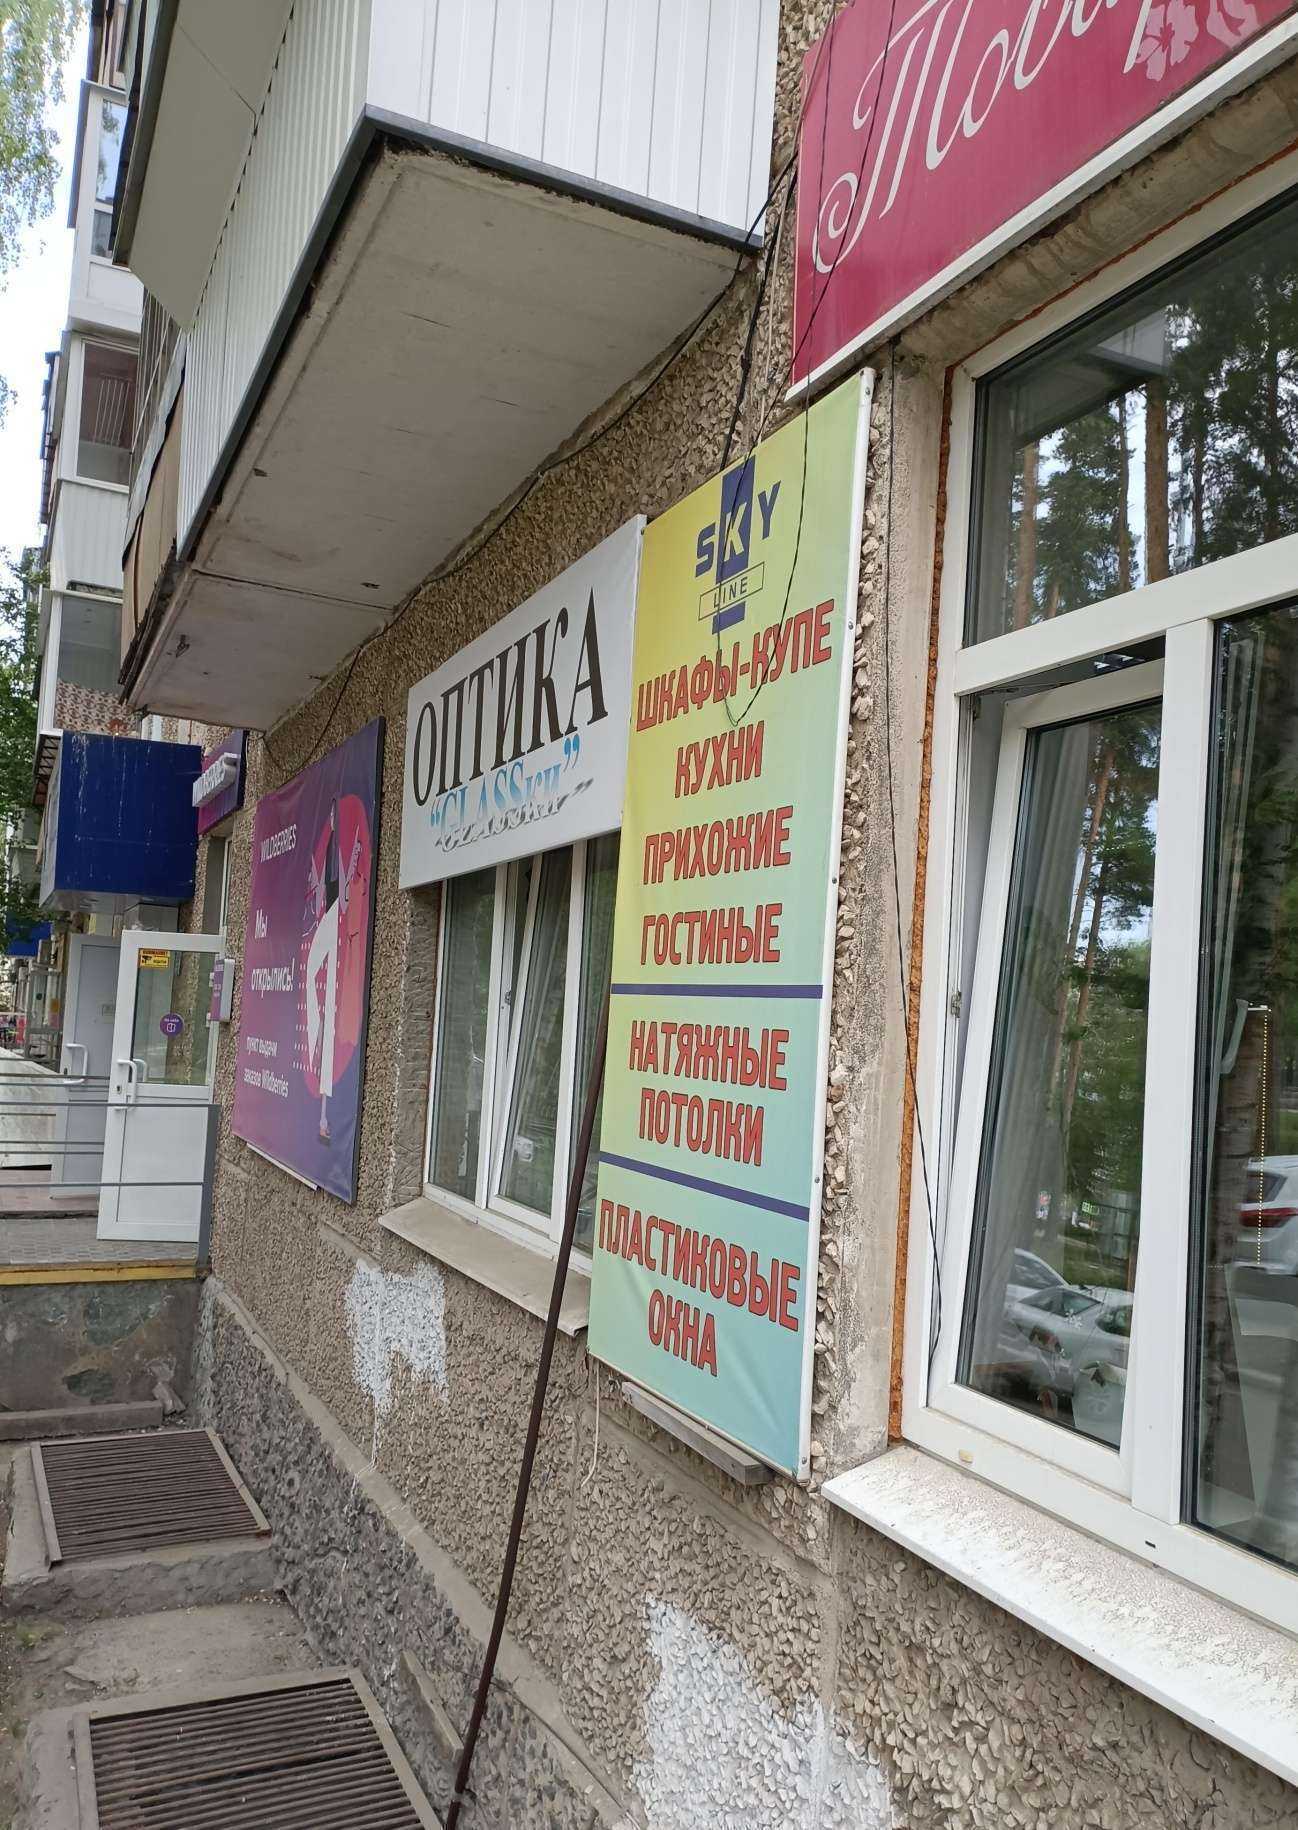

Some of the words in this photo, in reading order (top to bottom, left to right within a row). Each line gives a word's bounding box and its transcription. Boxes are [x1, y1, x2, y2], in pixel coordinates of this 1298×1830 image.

[695, 480, 781, 577] SKY
[713, 577, 748, 608] LINE
[413, 587, 608, 806] ОПТИКА
[636, 599, 835, 732] ШКАФЫ-КУПЕ
[675, 721, 765, 798] КУХНИ
[260, 824, 297, 862] WILDBERRIES
[643, 806, 793, 885] ПРИХОЖИЕ
[255, 908, 268, 940] Мы
[640, 903, 782, 965] ГОСТИНЫЕ
[251, 957, 295, 999] открылись!
[629, 1020, 789, 1091] НАТЯЖНЫЕ
[639, 1088, 764, 1167] ПОТОЛКИ
[598, 1199, 800, 1332] ПЛАСТИКОВЫЕ
[648, 1289, 718, 1378] ОКНА
